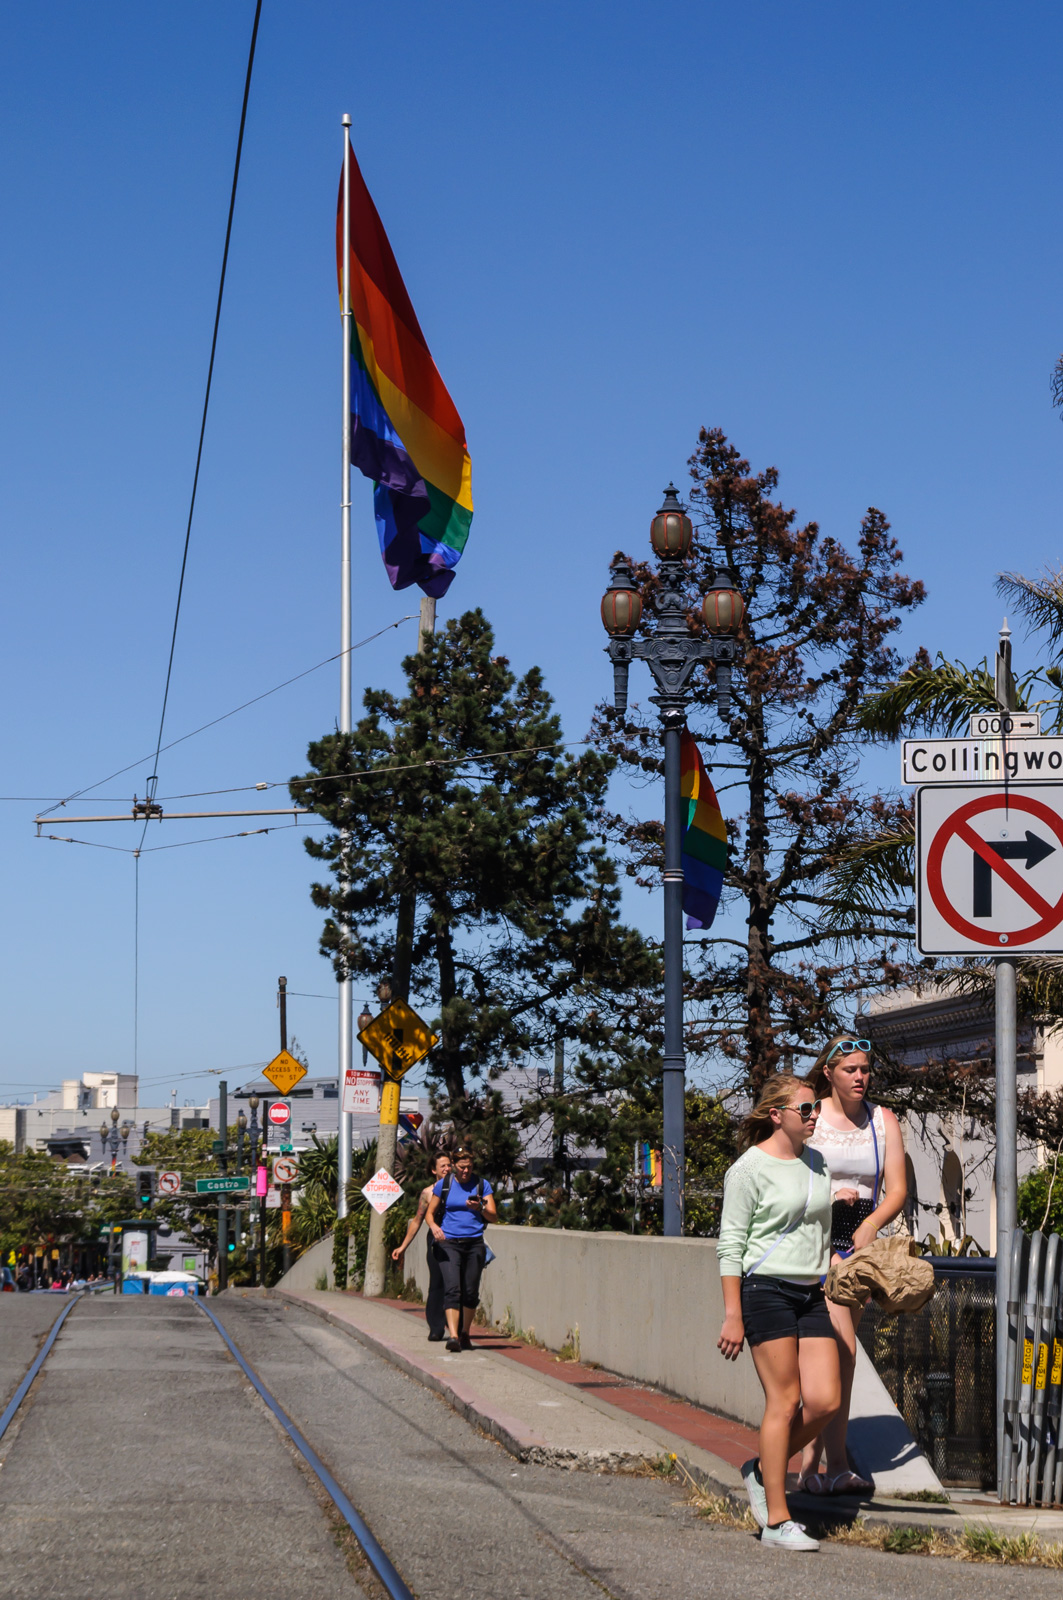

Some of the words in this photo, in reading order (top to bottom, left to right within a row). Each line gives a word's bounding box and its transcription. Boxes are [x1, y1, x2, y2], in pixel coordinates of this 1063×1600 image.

[911, 746, 1063, 778] Collingwo
[345, 1076, 356, 1086] NO
[354, 1089, 370, 1097] ANY
[352, 1096, 370, 1105] TIME
[377, 1172, 389, 1180] NO
[207, 1181, 239, 1189] Castro
[366, 1183, 400, 1193] STOPPING
